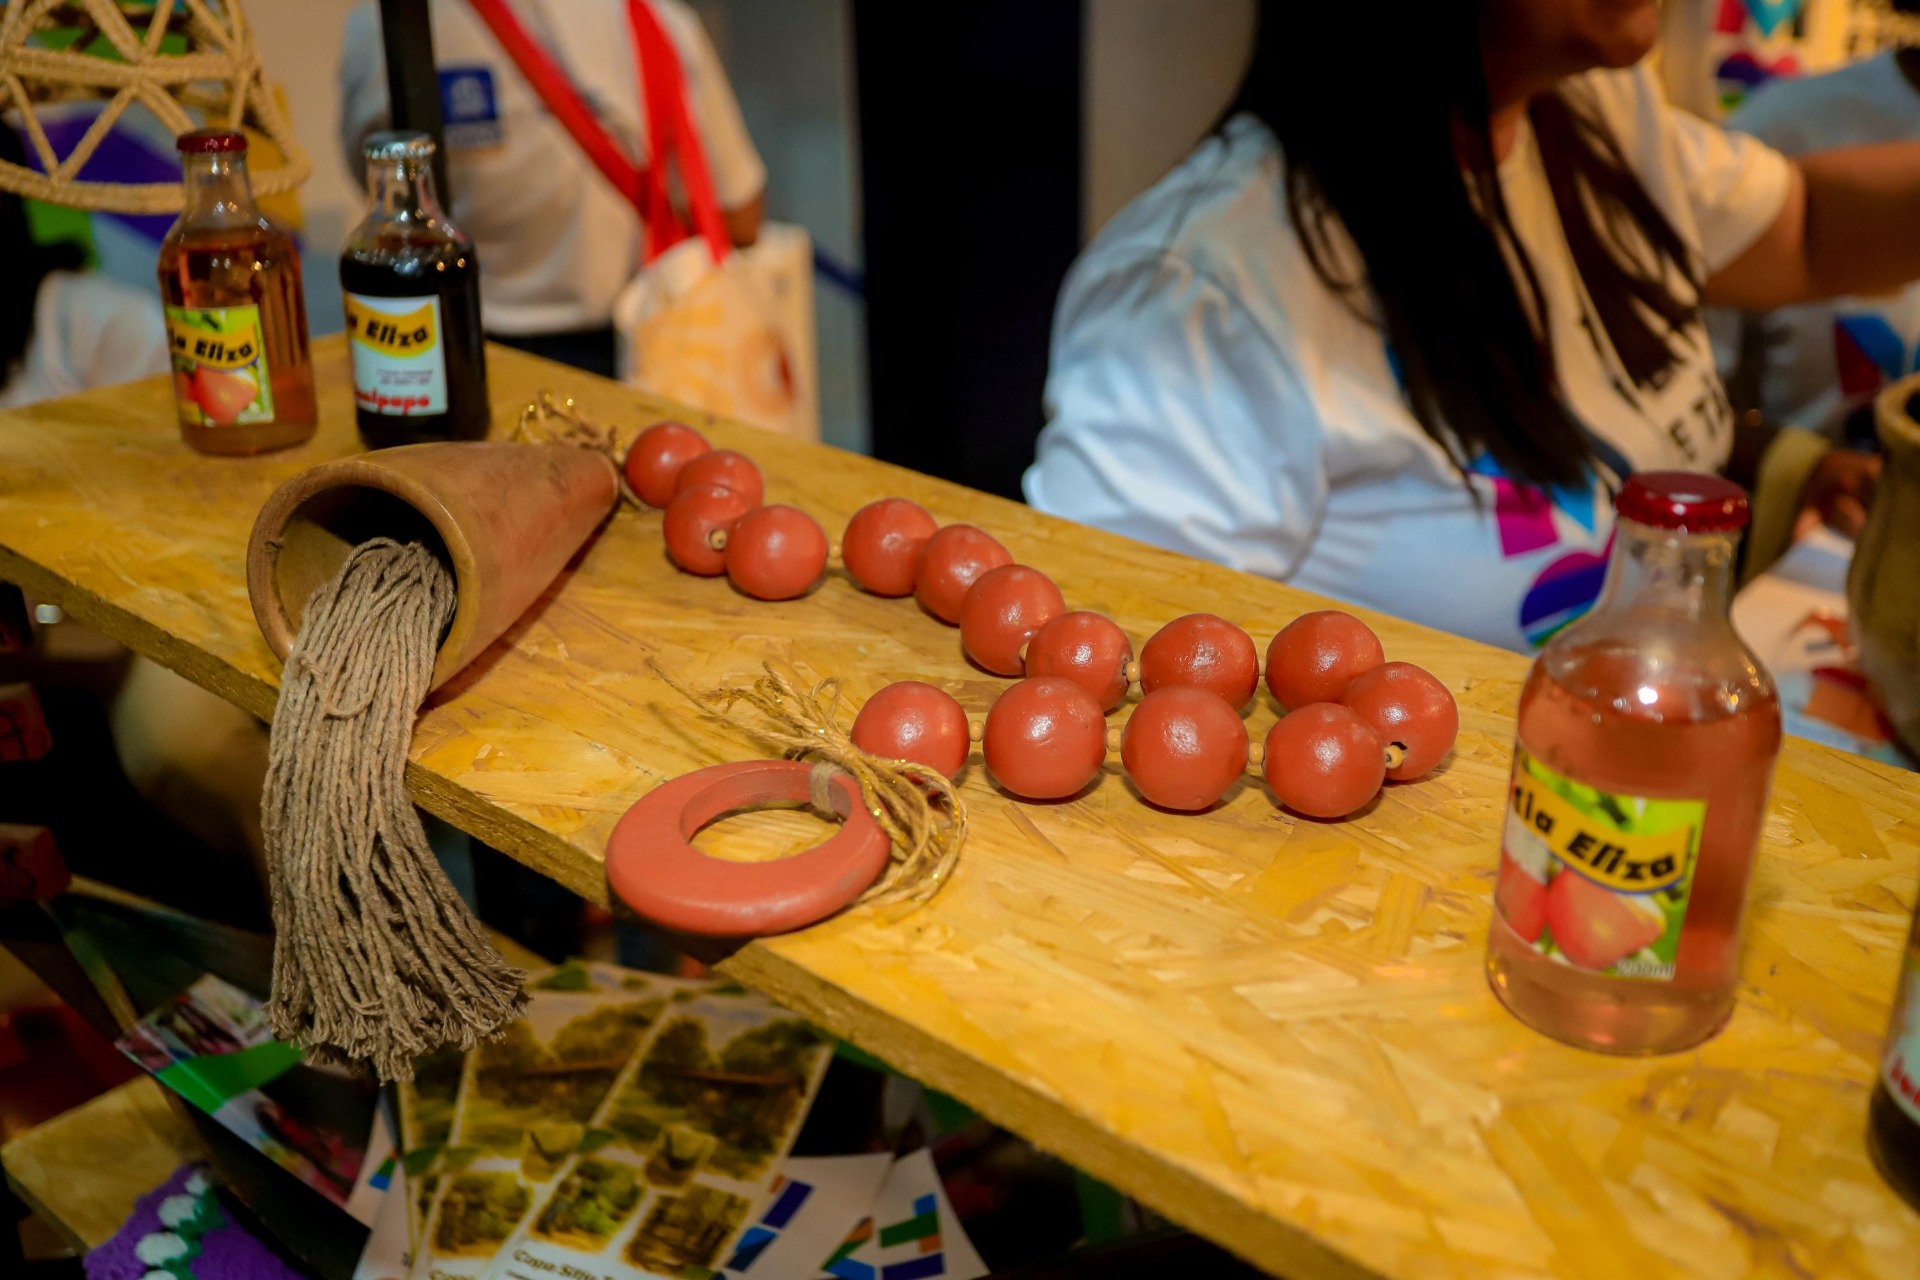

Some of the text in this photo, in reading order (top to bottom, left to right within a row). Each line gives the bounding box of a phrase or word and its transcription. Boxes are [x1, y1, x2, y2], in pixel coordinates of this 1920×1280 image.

[365, 319, 428, 347] Eliza
[195, 336, 253, 362] Eliza
[1566, 830, 1675, 881] Eliza
